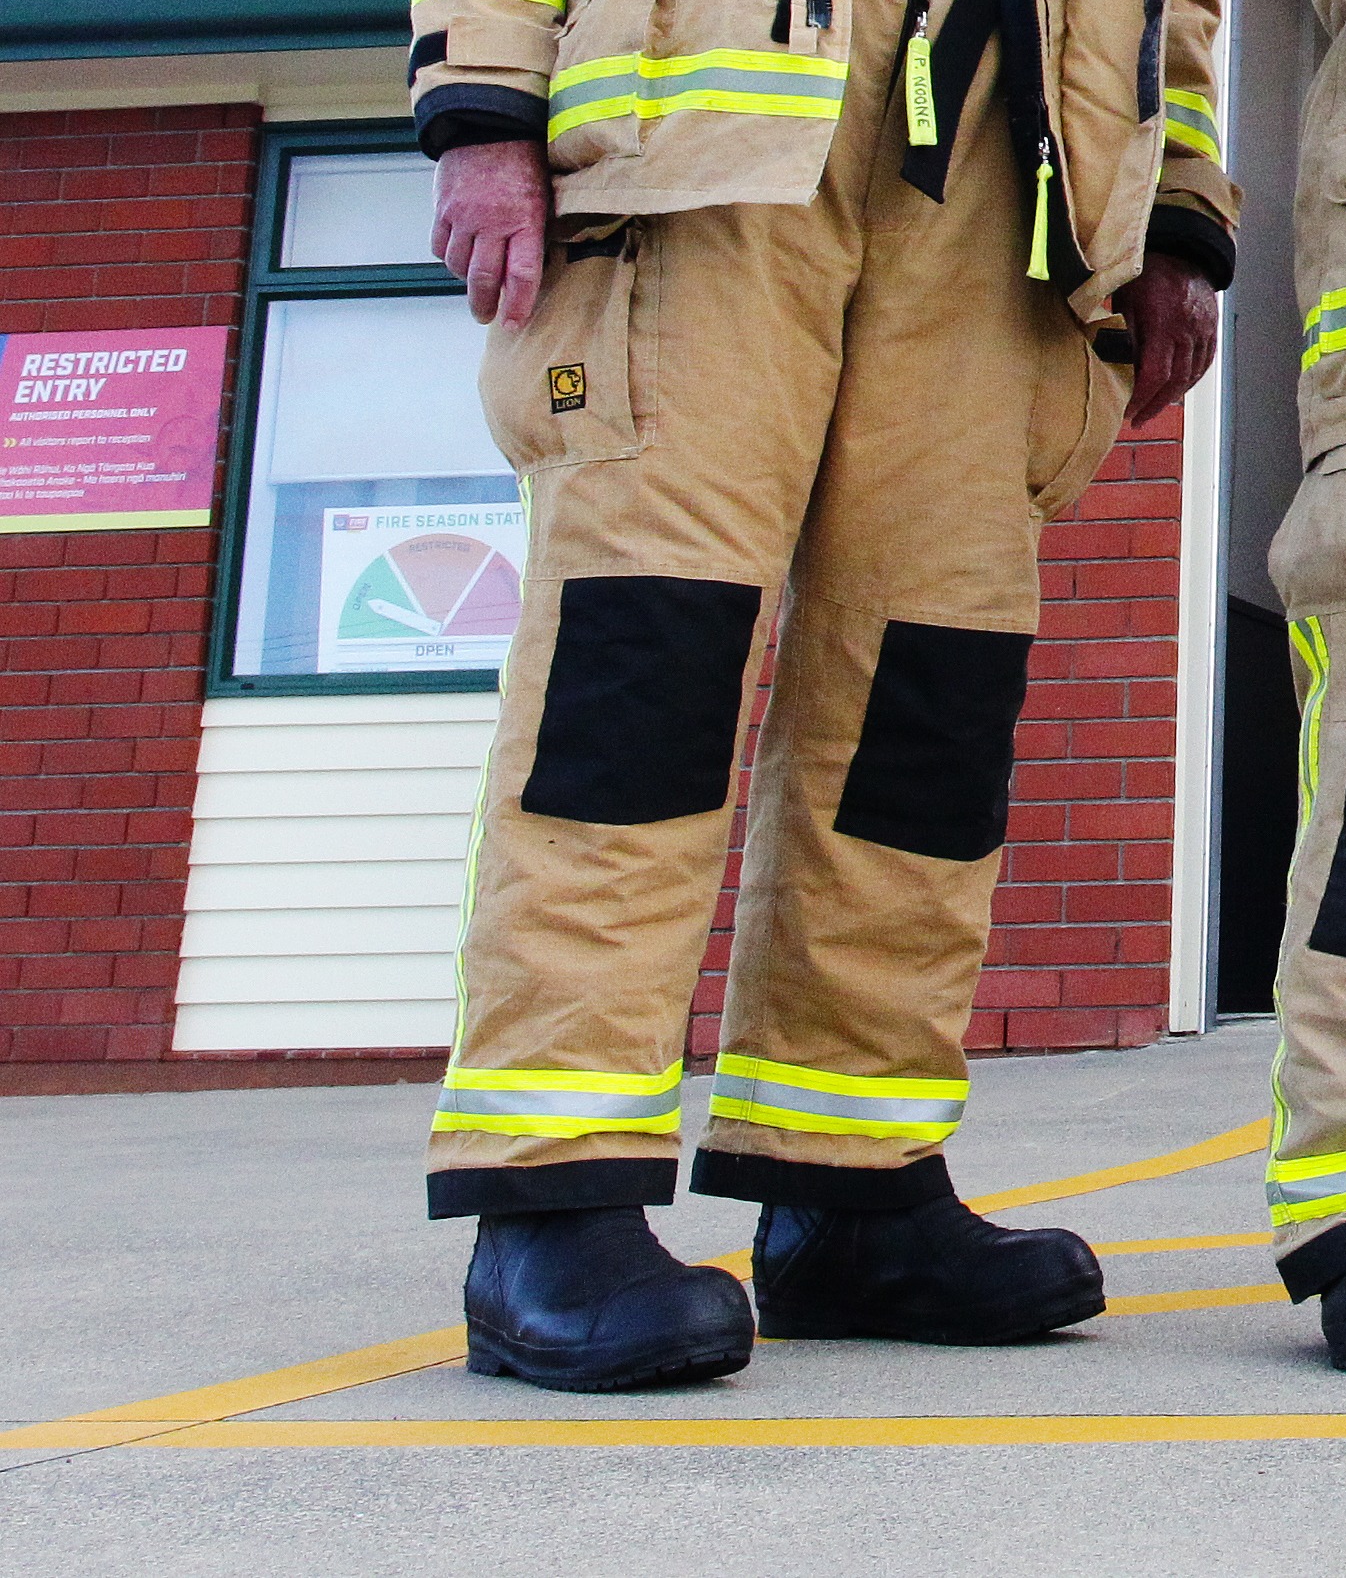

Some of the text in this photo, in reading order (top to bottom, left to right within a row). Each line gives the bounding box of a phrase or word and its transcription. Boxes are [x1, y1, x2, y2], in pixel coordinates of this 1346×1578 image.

[912, 56, 931, 129] P. NOONE
[20, 348, 188, 377] RESTRICTED
[13, 378, 107, 404] ENTRY
[9, 407, 157, 422] AUTHORISED PERSONNEL ONLY
[376, 515, 411, 528] FIRE
[416, 513, 479, 527] SEASON
[484, 512, 522, 525] STAT
[409, 541, 471, 552] RESTRICTED
[415, 644, 455, 657] OPEN
